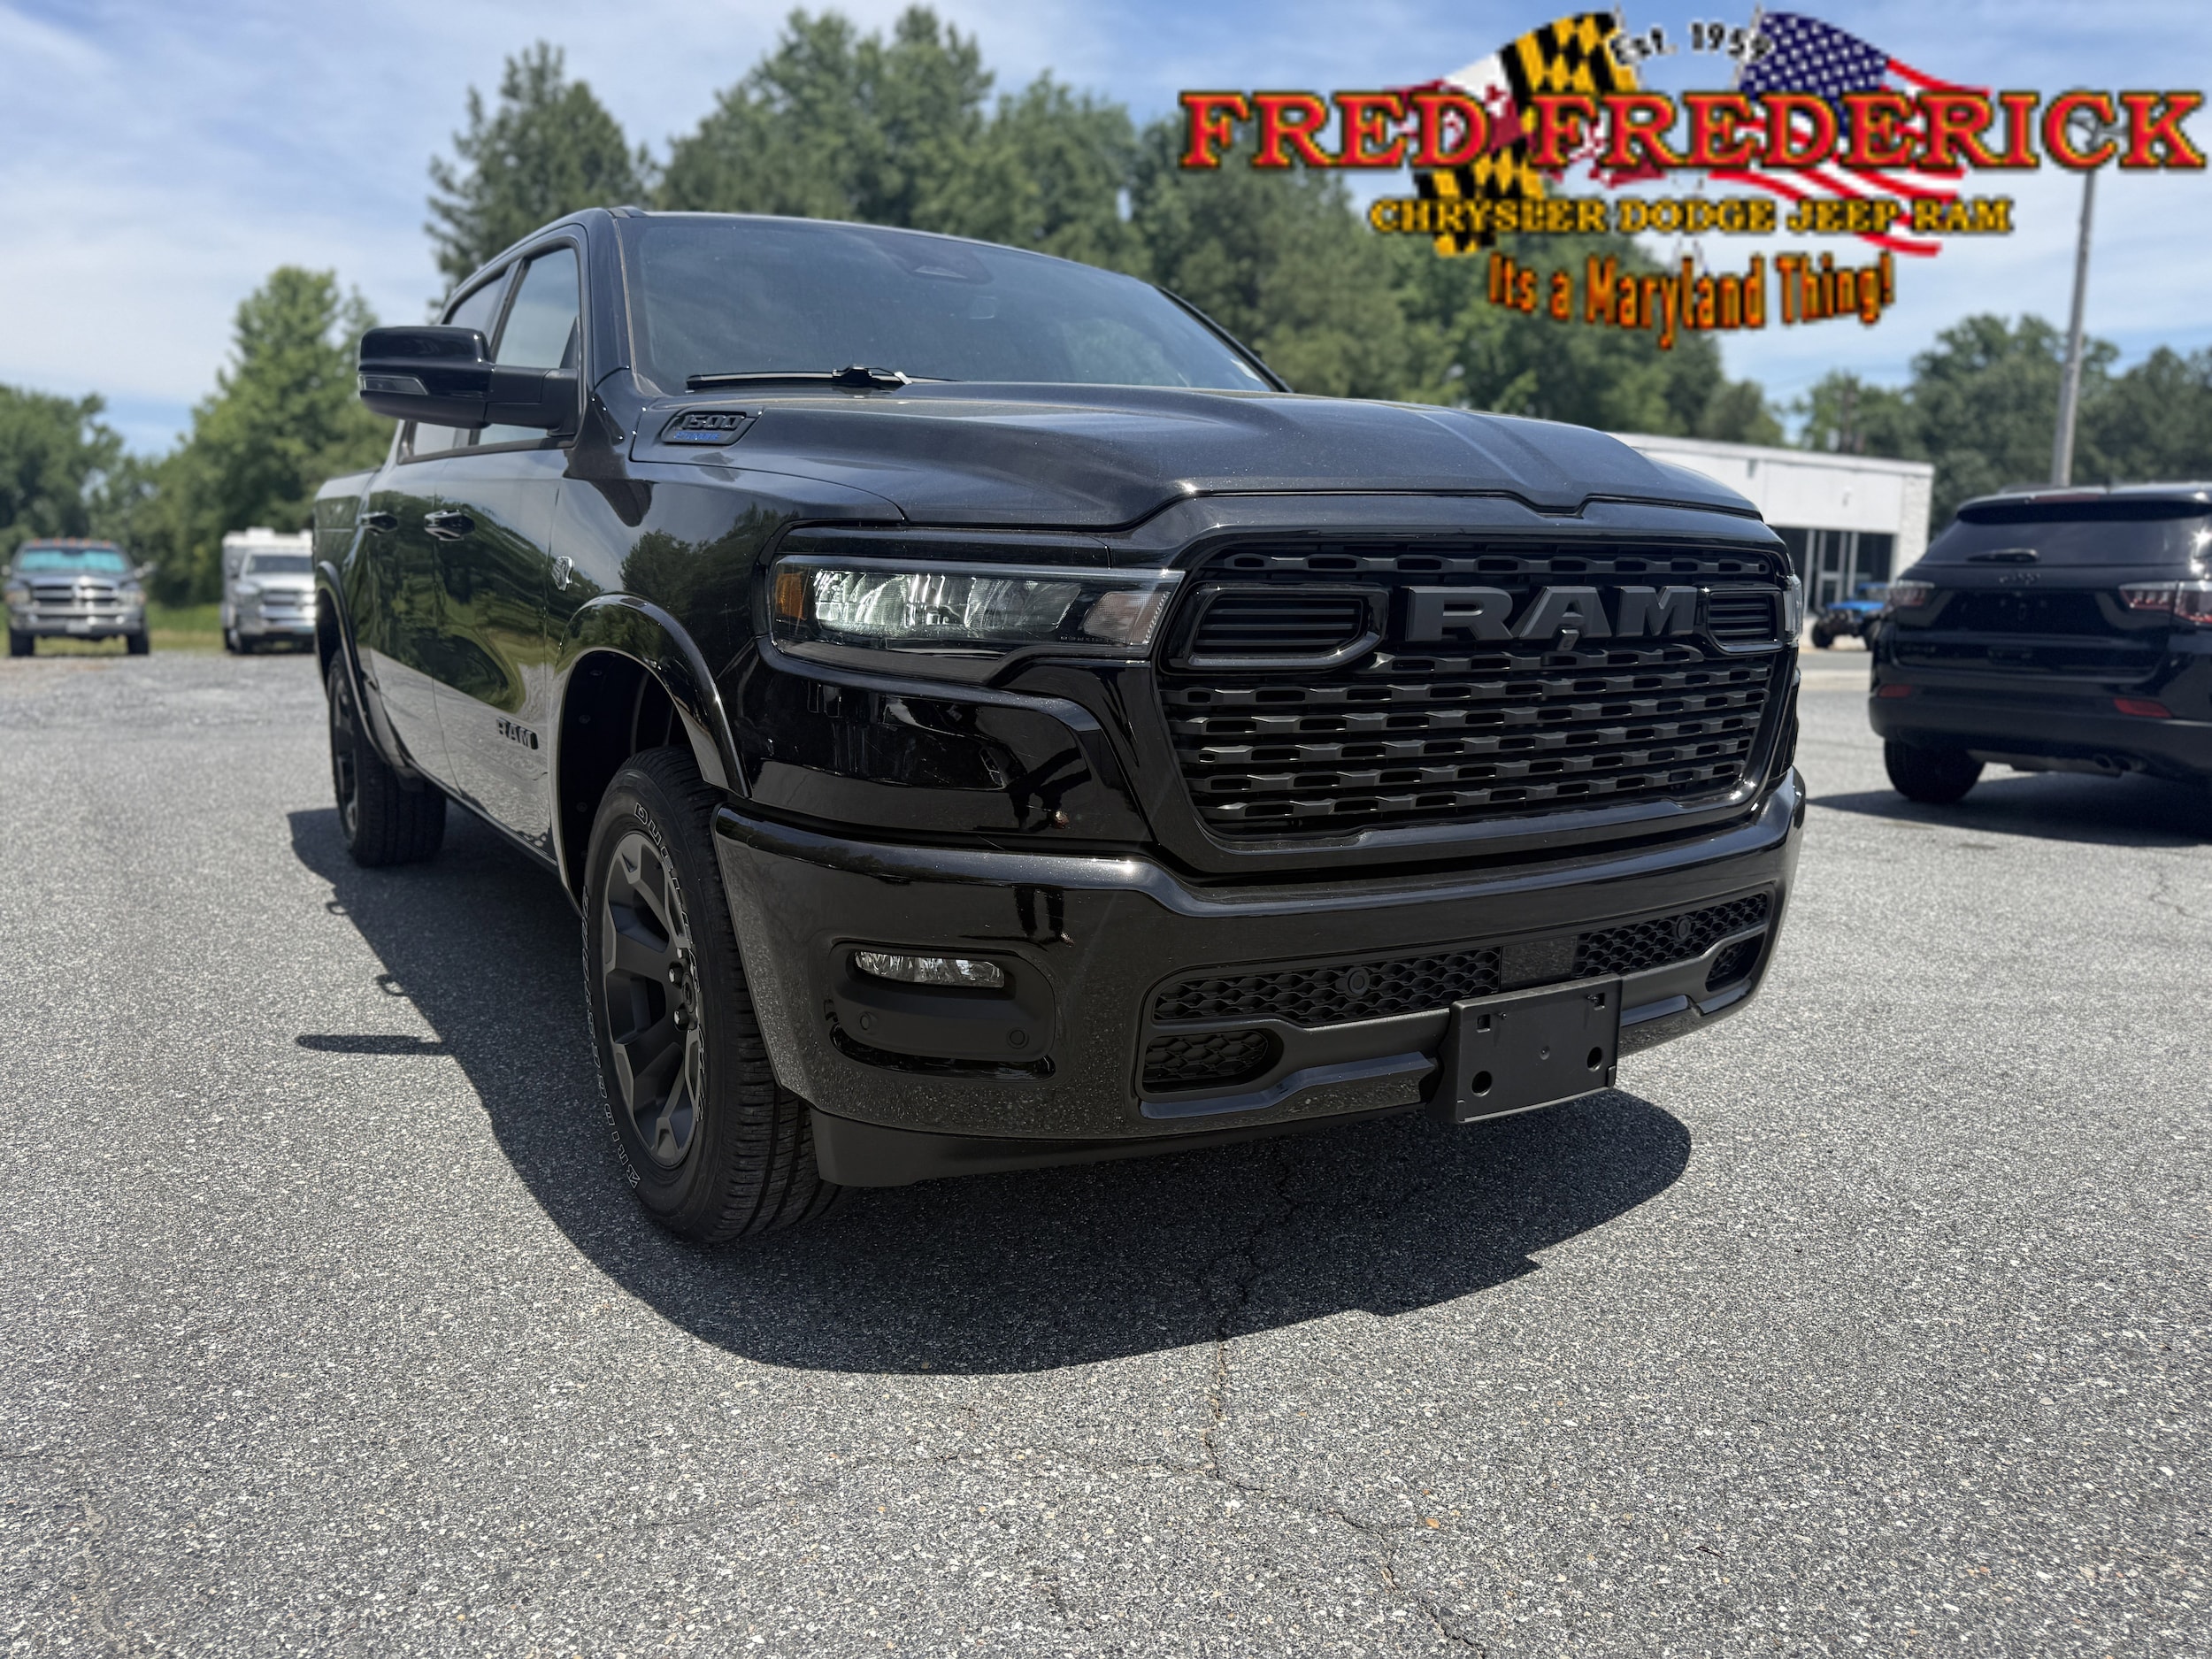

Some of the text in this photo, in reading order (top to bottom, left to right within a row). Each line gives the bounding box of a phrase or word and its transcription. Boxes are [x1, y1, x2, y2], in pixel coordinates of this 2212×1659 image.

[681, 414, 744, 430] 1500
[1404, 585, 1698, 642] RAM
[495, 717, 538, 749] RAM
